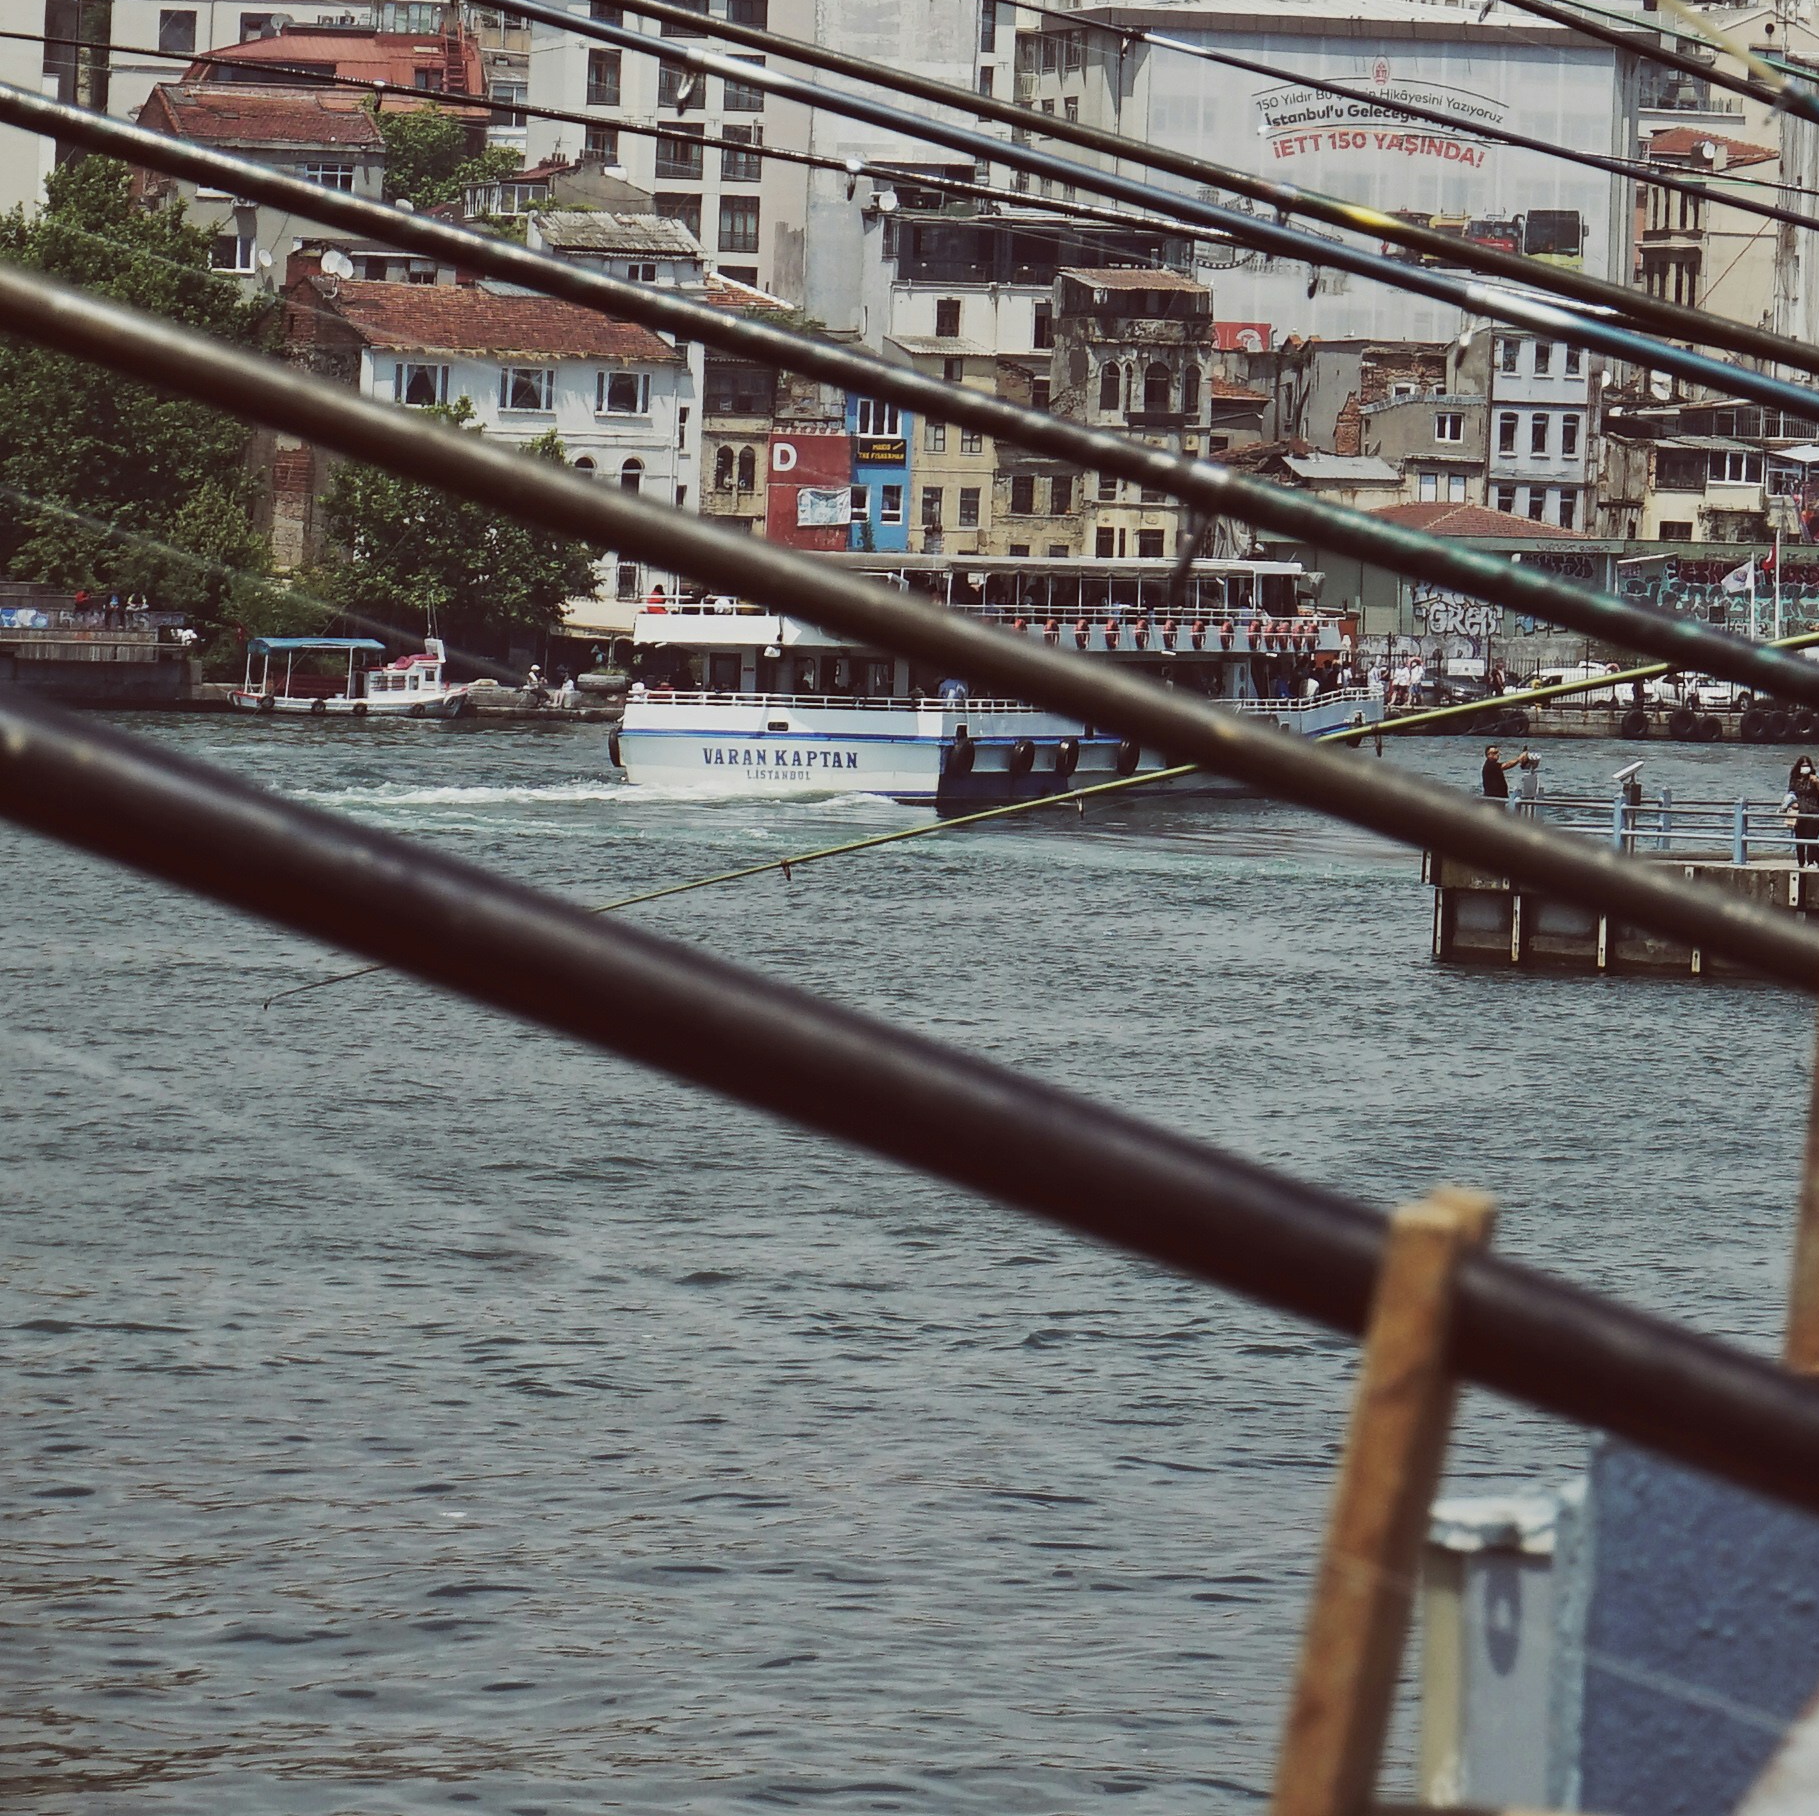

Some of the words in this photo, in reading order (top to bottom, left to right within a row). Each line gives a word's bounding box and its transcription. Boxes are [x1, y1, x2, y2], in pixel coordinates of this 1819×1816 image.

[1256, 96, 1279, 112] 150
[1281, 91, 1313, 106] Yıldır
[1380, 88, 1444, 106] Hikâyesini
[1447, 96, 1504, 124] Yazıyoruz
[1328, 131, 1367, 151] 150
[1373, 132, 1486, 168] YAŞINDA!
[772, 442, 798, 472] D
[703, 748, 767, 766] VARAN
[774, 749, 859, 769] KAPTAN
